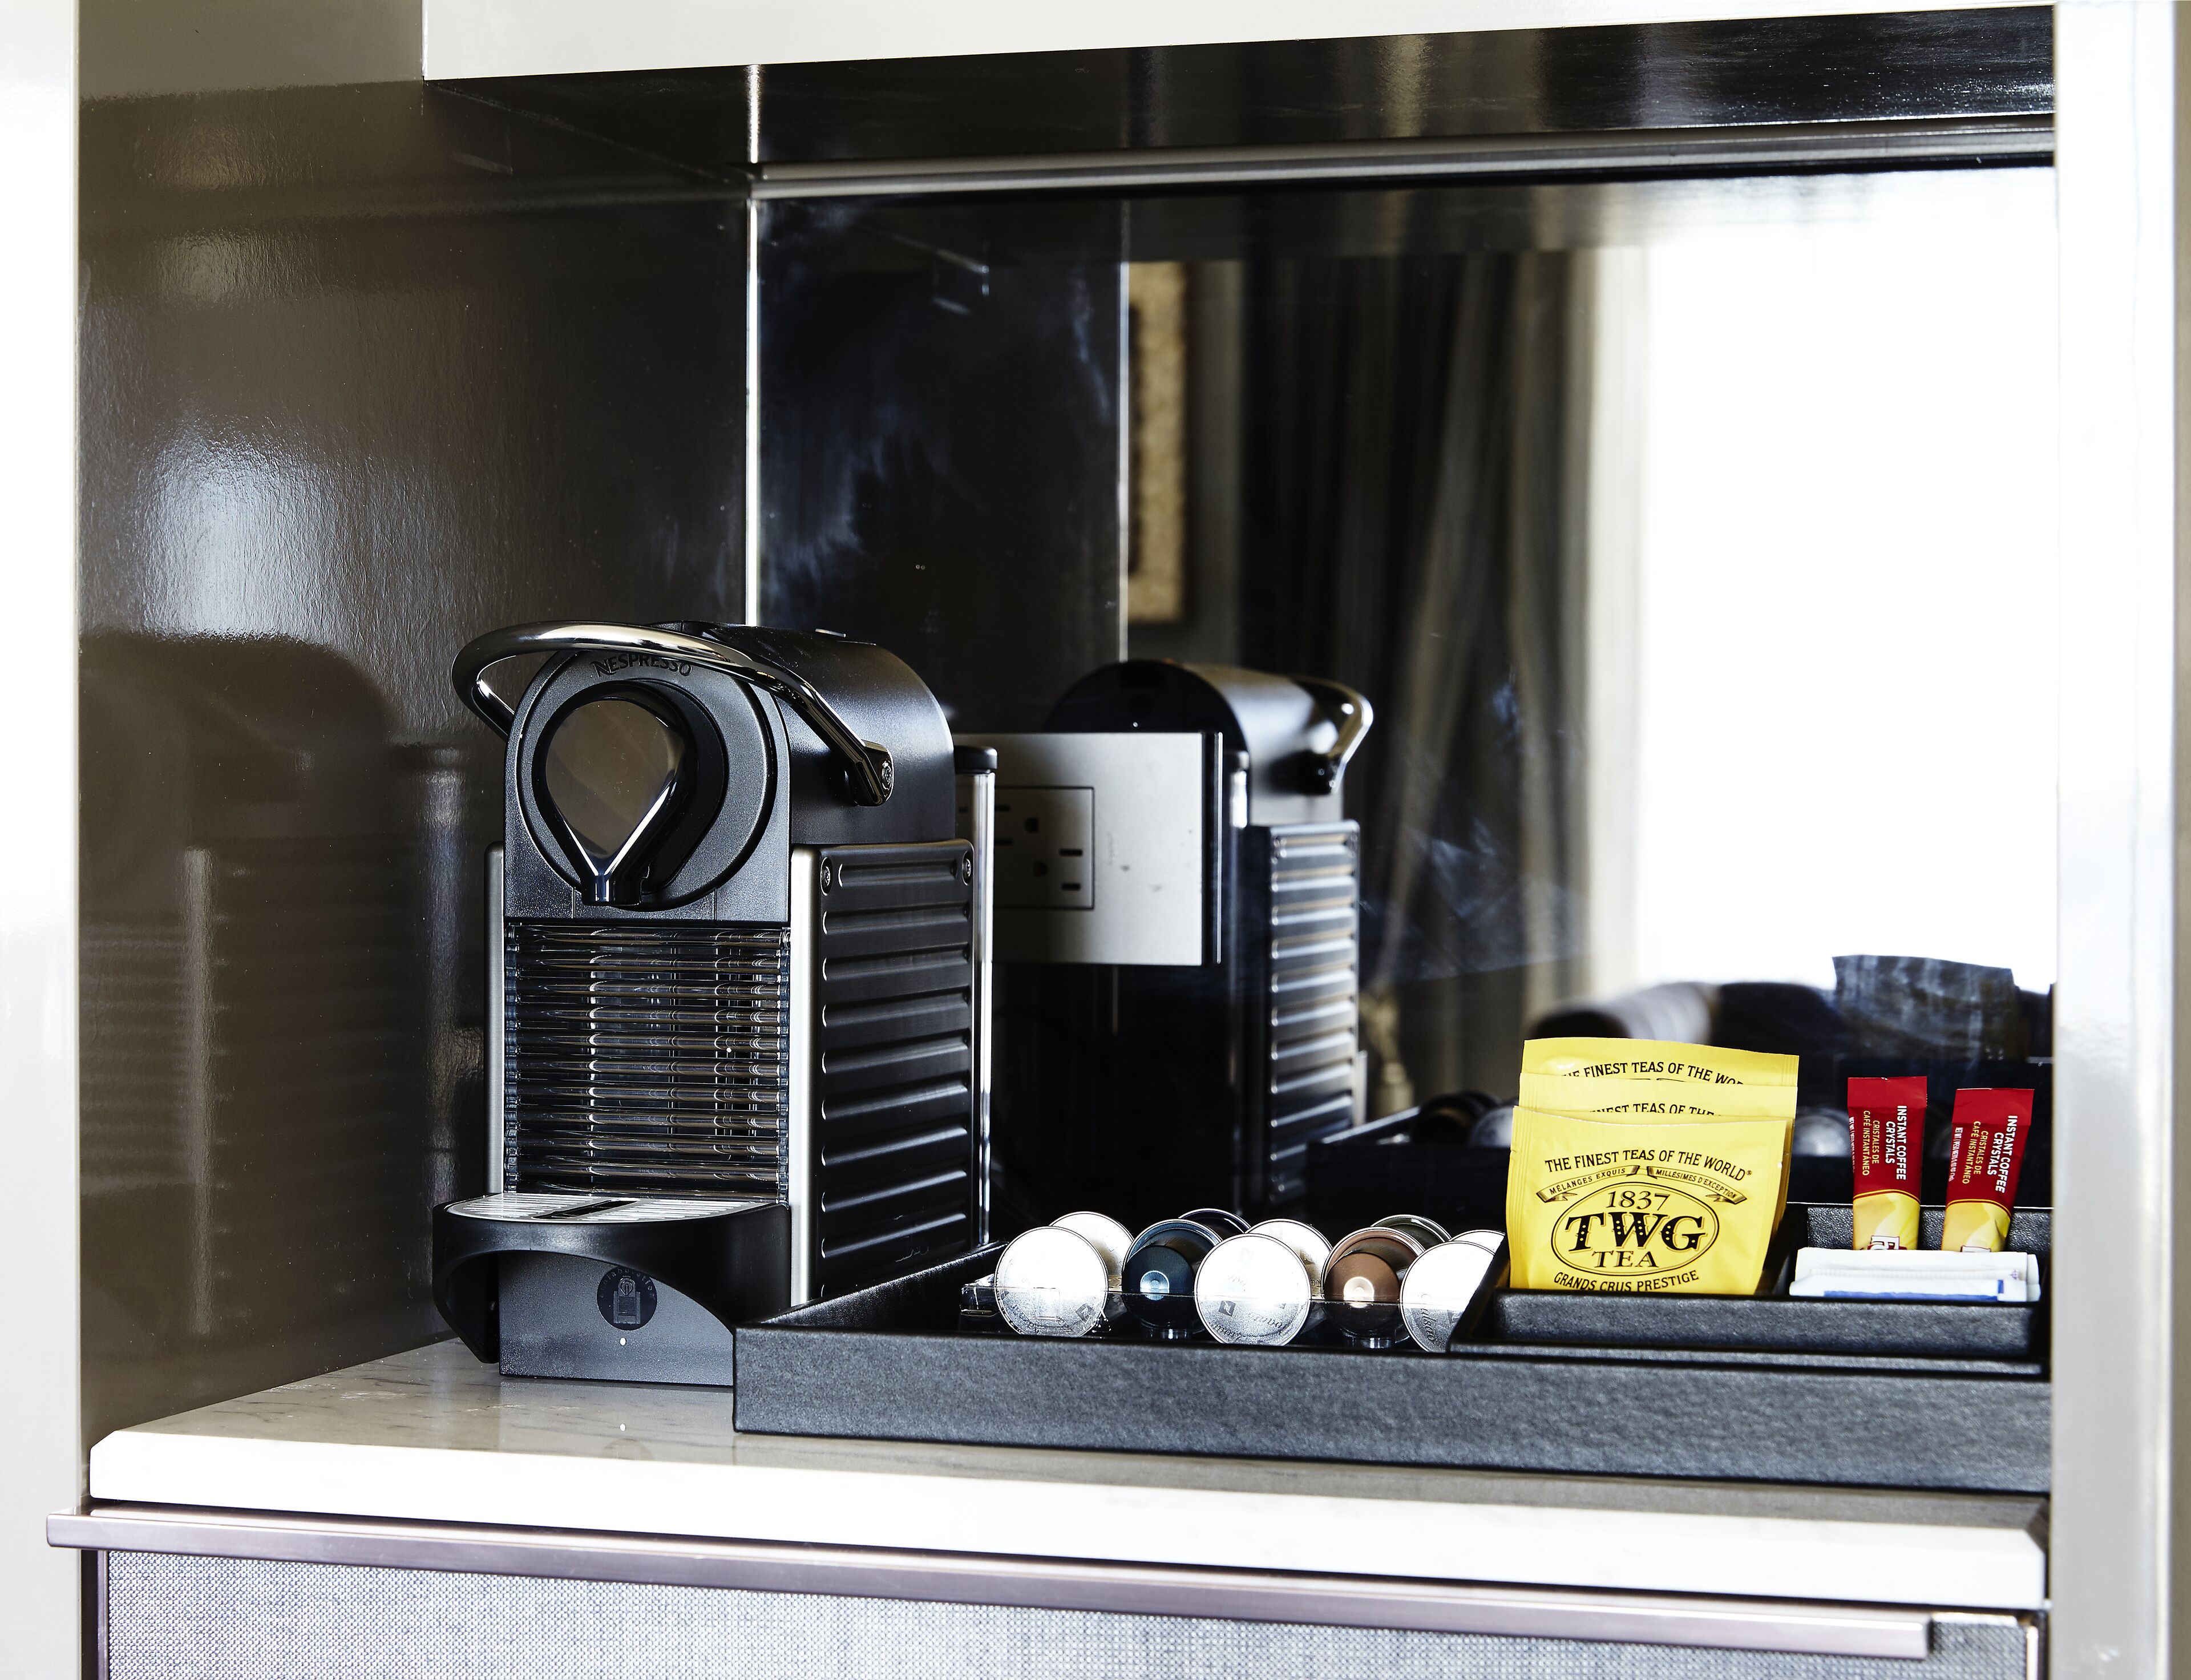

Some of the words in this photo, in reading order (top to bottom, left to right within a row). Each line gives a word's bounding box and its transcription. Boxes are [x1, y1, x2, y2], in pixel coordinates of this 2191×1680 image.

[591, 654, 693, 677] NESPRESSO
[1583, 1063, 1628, 1077] FINEST
[1631, 1061, 1664, 1073] TEAS
[1668, 1062, 1684, 1075] OF
[1687, 1065, 1713, 1081] THE
[1632, 1102, 1666, 1113] TEAS
[1669, 1104, 1685, 1114] OF
[1863, 1110, 1872, 1126] CAFÉ
[1897, 1105, 1907, 1144] INSTANT
[1971, 1120, 1981, 1138] CAFÉ
[2002, 1115, 2018, 1156] INSTANT
[1862, 1128, 1871, 1176] INSTANTÁNEO
[1885, 1121, 1896, 1164] CRYSTALS
[1975, 1130, 1989, 1164] CRISTALES
[1987, 1132, 2004, 1176] CRYSTALS
[1545, 1157, 1572, 1173] THE
[1574, 1151, 1619, 1169] FINEST
[1623, 1149, 1655, 1161] TEAS
[1659, 1150, 1675, 1162] OF
[1678, 1151, 1702, 1166] THE
[1872, 1154, 1879, 1164] DE
[1896, 1145, 1906, 1180] COFFEE
[1962, 1138, 1978, 1184] INSTANTÁNEO
[1973, 1165, 1982, 1175] DE
[1549, 1176, 1592, 1195] MÉLANGES
[1596, 1168, 1626, 1180] EXQUIS
[1656, 1169, 1697, 1182] MILLÉSIMES
[1697, 1177, 1738, 1199] D'EXCEPTION
[1995, 1156, 2011, 1193] COFFEE
[1606, 1190, 1671, 1211] 1837
[1565, 1211, 1707, 1252] TWG
[1592, 1250, 1659, 1268] TEA
[1554, 1271, 1596, 1291] GRANDS
[1599, 1281, 1631, 1292] CRUS
[1636, 1270, 1699, 1292] PRESTIGE
